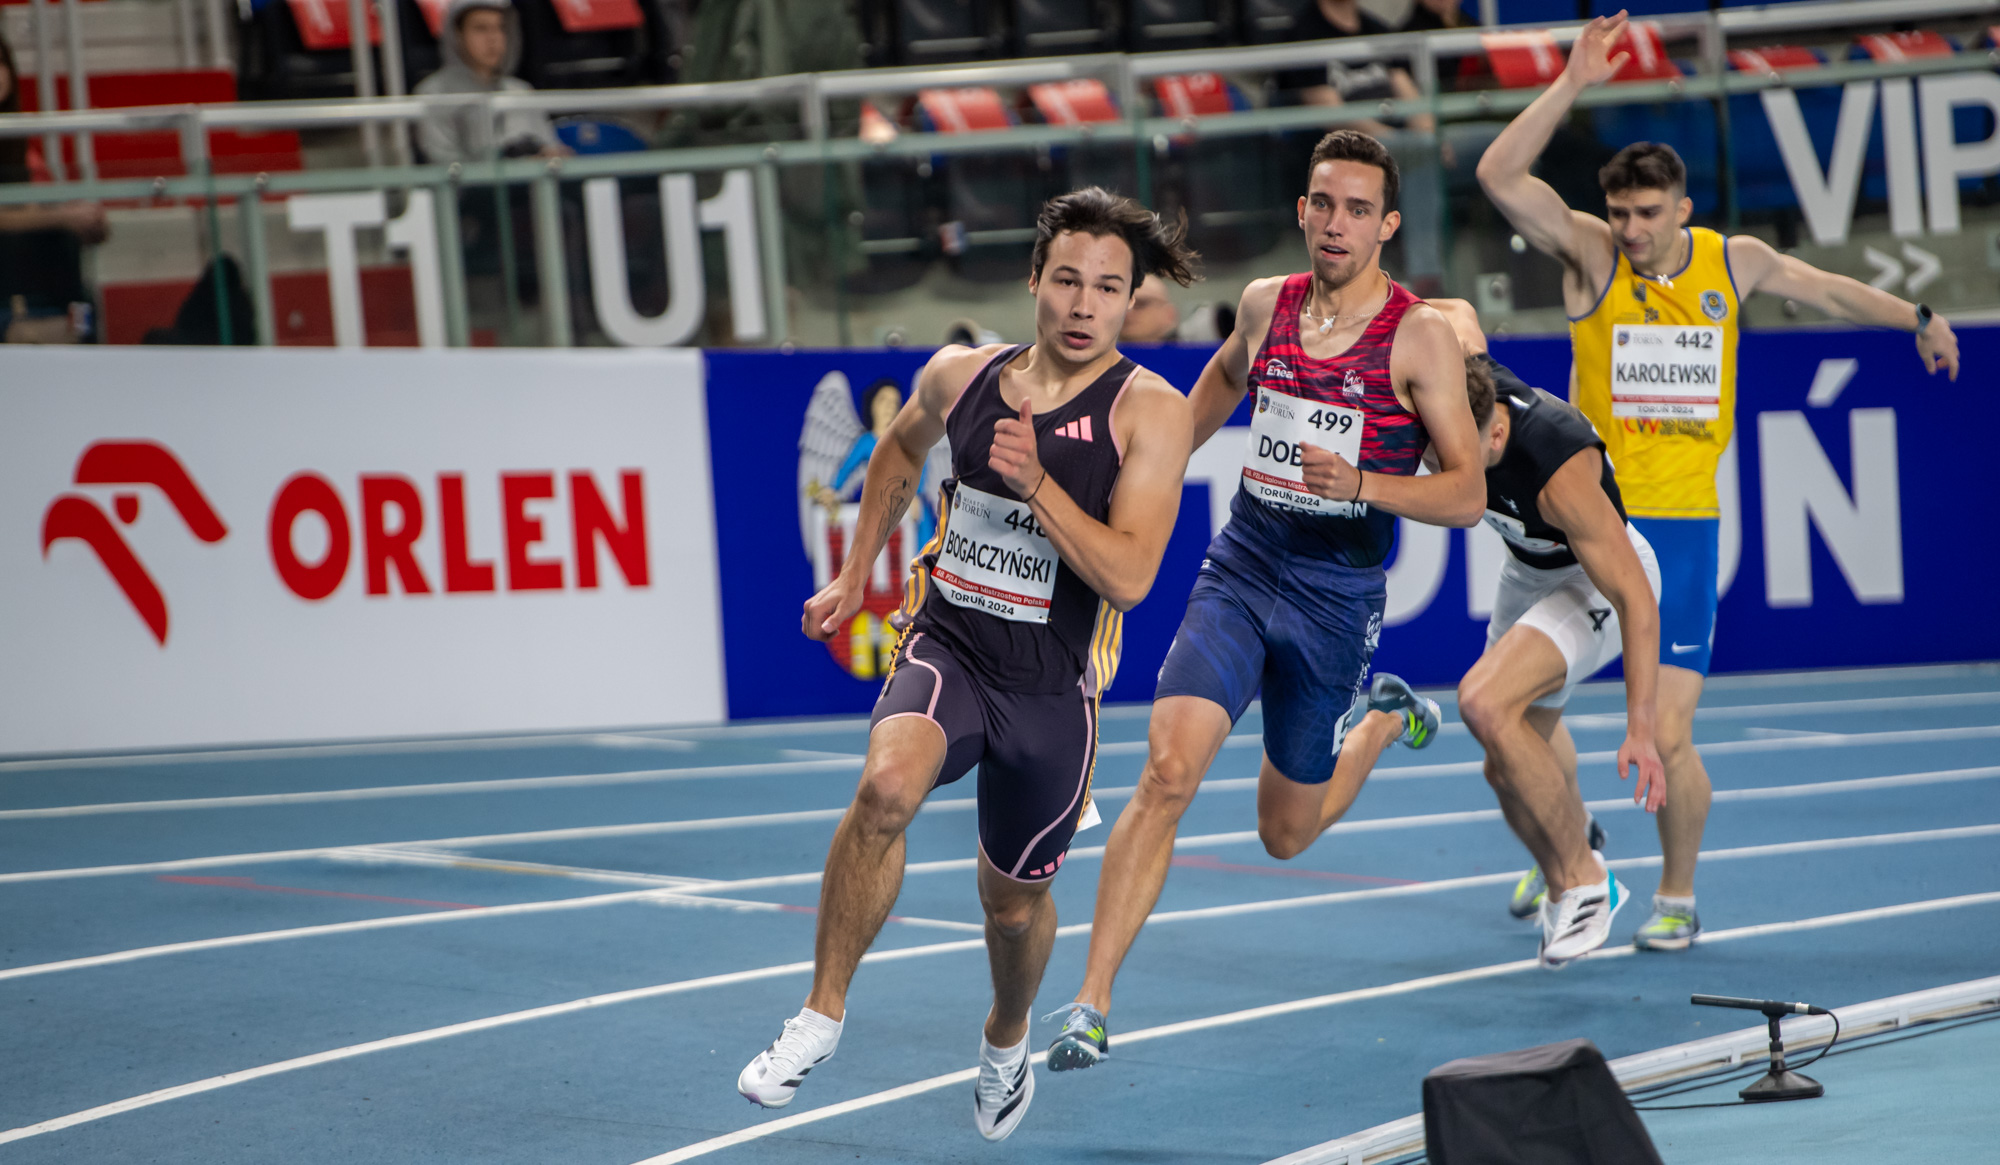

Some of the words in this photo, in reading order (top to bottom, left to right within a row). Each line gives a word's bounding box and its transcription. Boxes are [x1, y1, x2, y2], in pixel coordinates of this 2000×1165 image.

[1760, 70, 2000, 246] VIP
[287, 188, 446, 346] T1
[583, 169, 767, 347] U1
[1675, 331, 1713, 349] 442
[1266, 365, 1294, 380] Enea
[1616, 362, 1716, 384] KAROLEWSKI
[1270, 405, 1296, 420] TORUŃ
[1272, 400, 1290, 409] MIASTO
[1637, 403, 1669, 413] TORUŃ
[1671, 405, 1694, 414] 2024
[1307, 408, 1353, 434] 499
[1257, 434, 1341, 467] DOB
[1252, 471, 1265, 481] PZLA
[1264, 475, 1287, 487] Halowe
[963, 496, 985, 508] MIASTO
[1259, 486, 1293, 501] TORUŃ
[1294, 494, 1320, 508] 2024
[961, 502, 991, 520] TORUŃ
[266, 468, 653, 602] ORLEN
[945, 529, 1052, 583] BOGACZYŃSKI
[936, 569, 945, 579] 68.
[945, 573, 958, 584] PZLA
[957, 579, 979, 591] Halowe
[980, 585, 1022, 604] Mistrzostwa
[1023, 597, 1046, 607] Polski
[950, 589, 986, 608] TORUŃ
[987, 600, 1015, 616] 2024
